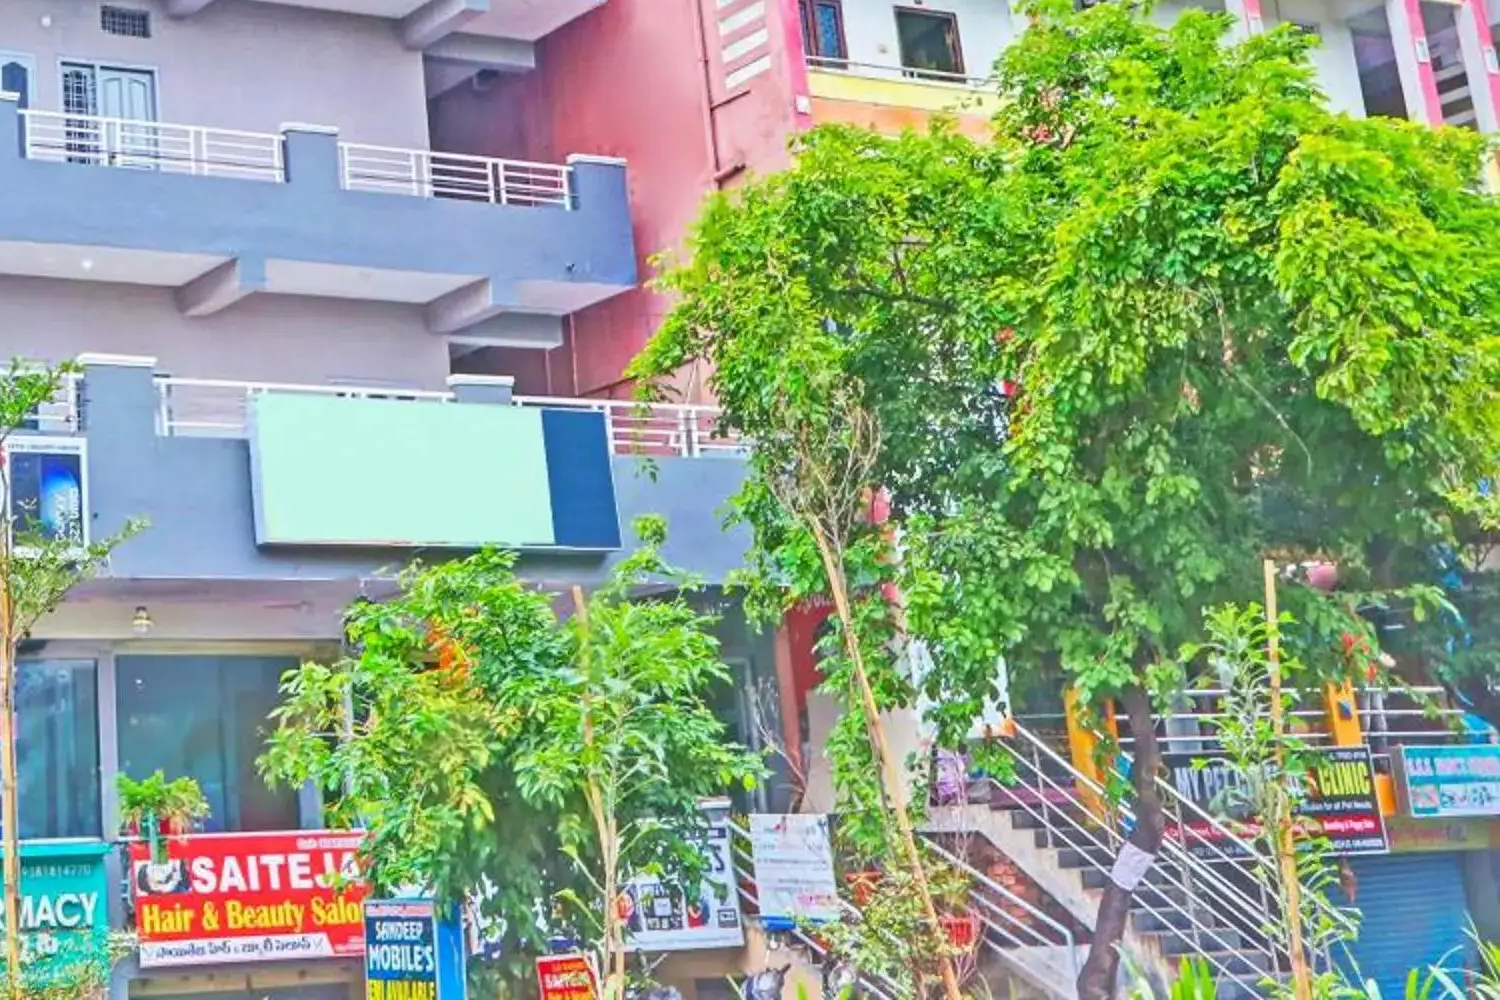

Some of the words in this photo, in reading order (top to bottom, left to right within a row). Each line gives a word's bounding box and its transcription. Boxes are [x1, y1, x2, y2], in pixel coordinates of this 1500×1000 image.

[1317, 760, 1372, 796] CLINIC
[142, 902, 195, 934] Hair
[202, 901, 220, 931] &
[226, 898, 305, 934] Beauty
[311, 894, 364, 926] Salo
[375, 920, 423, 941] SANDEEP
